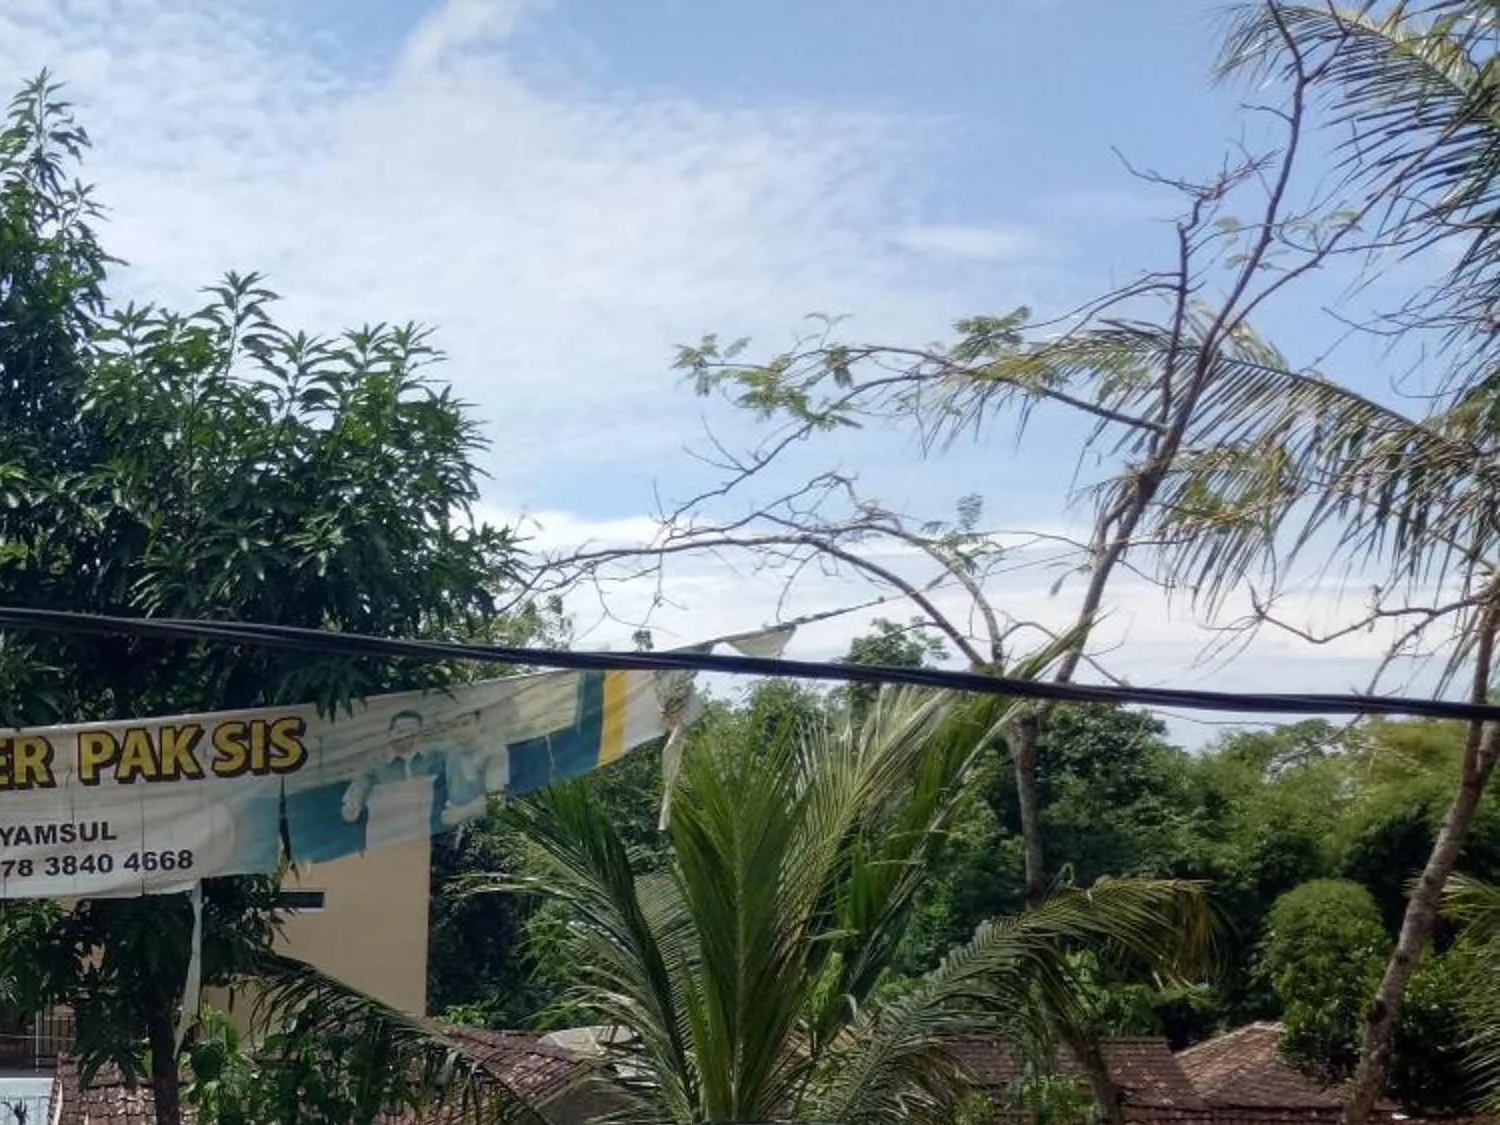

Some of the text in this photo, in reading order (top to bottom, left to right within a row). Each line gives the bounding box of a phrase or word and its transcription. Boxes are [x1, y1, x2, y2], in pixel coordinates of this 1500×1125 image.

[78, 724, 205, 786] PAK
[211, 716, 308, 778] SIS
[44, 854, 113, 876] 3840
[124, 850, 193, 872] 4668
